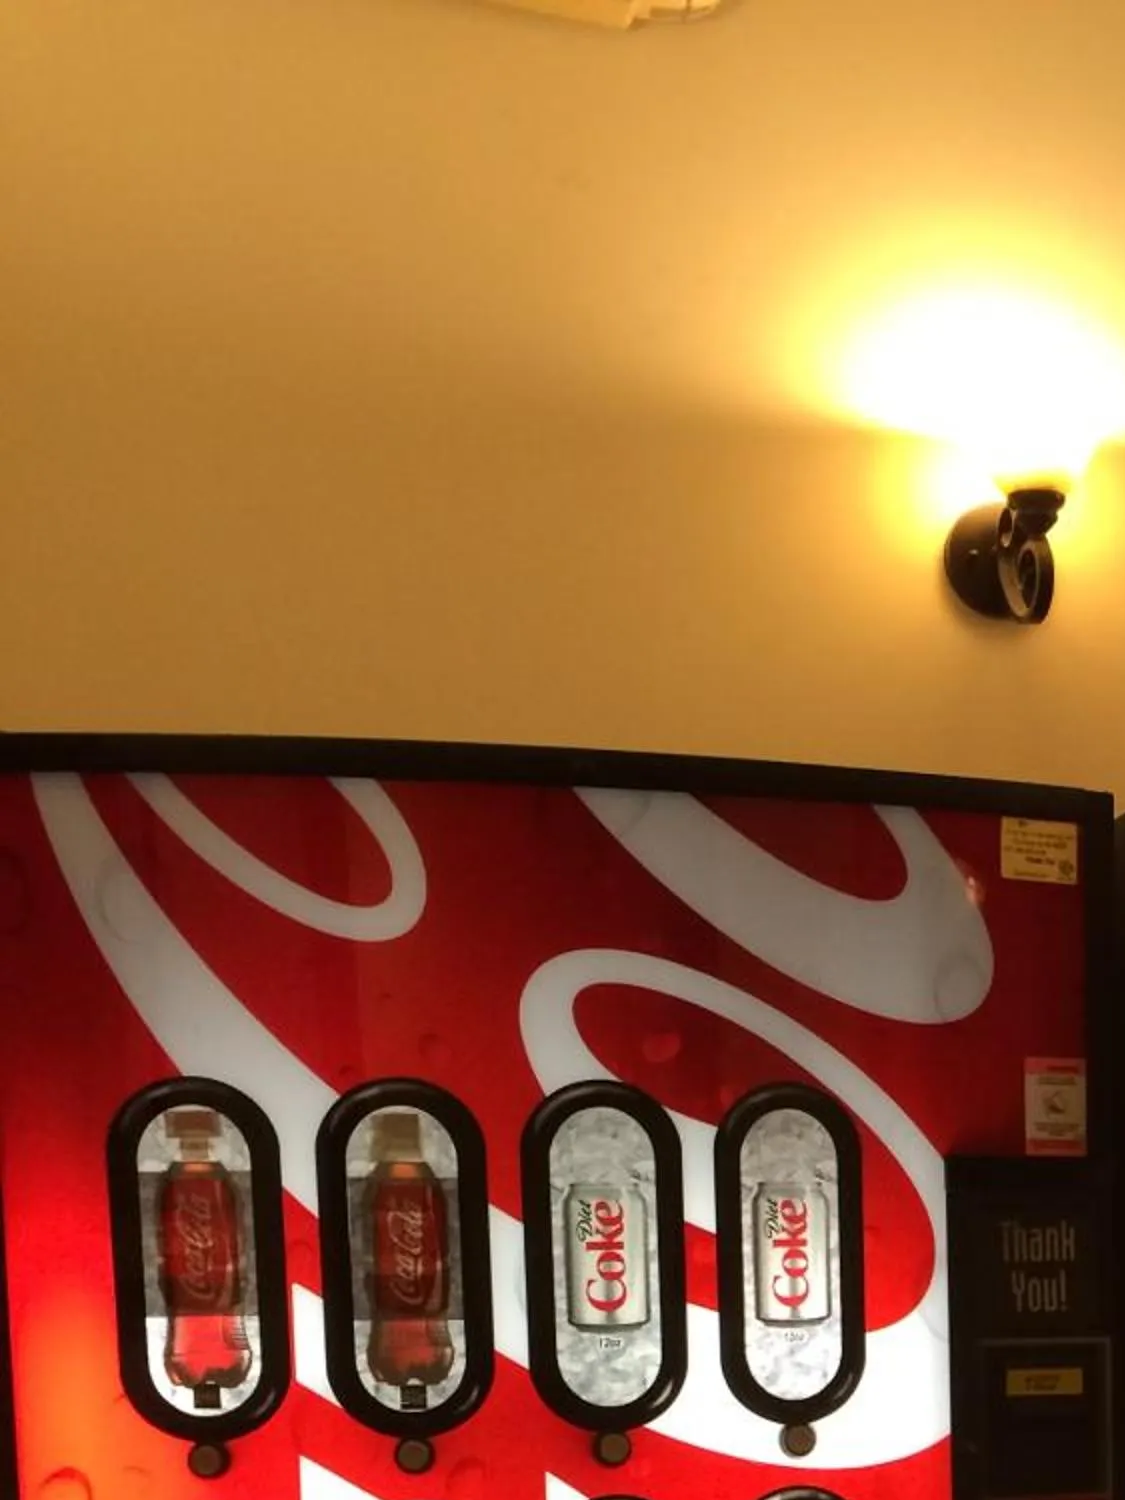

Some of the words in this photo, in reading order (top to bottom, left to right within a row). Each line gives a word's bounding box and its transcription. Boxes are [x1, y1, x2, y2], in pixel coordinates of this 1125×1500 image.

[585, 1198, 628, 1314] Coke
[771, 1198, 809, 1308] Coke
[997, 1218, 1076, 1264] Thank
[1011, 1267, 1069, 1313] You!
